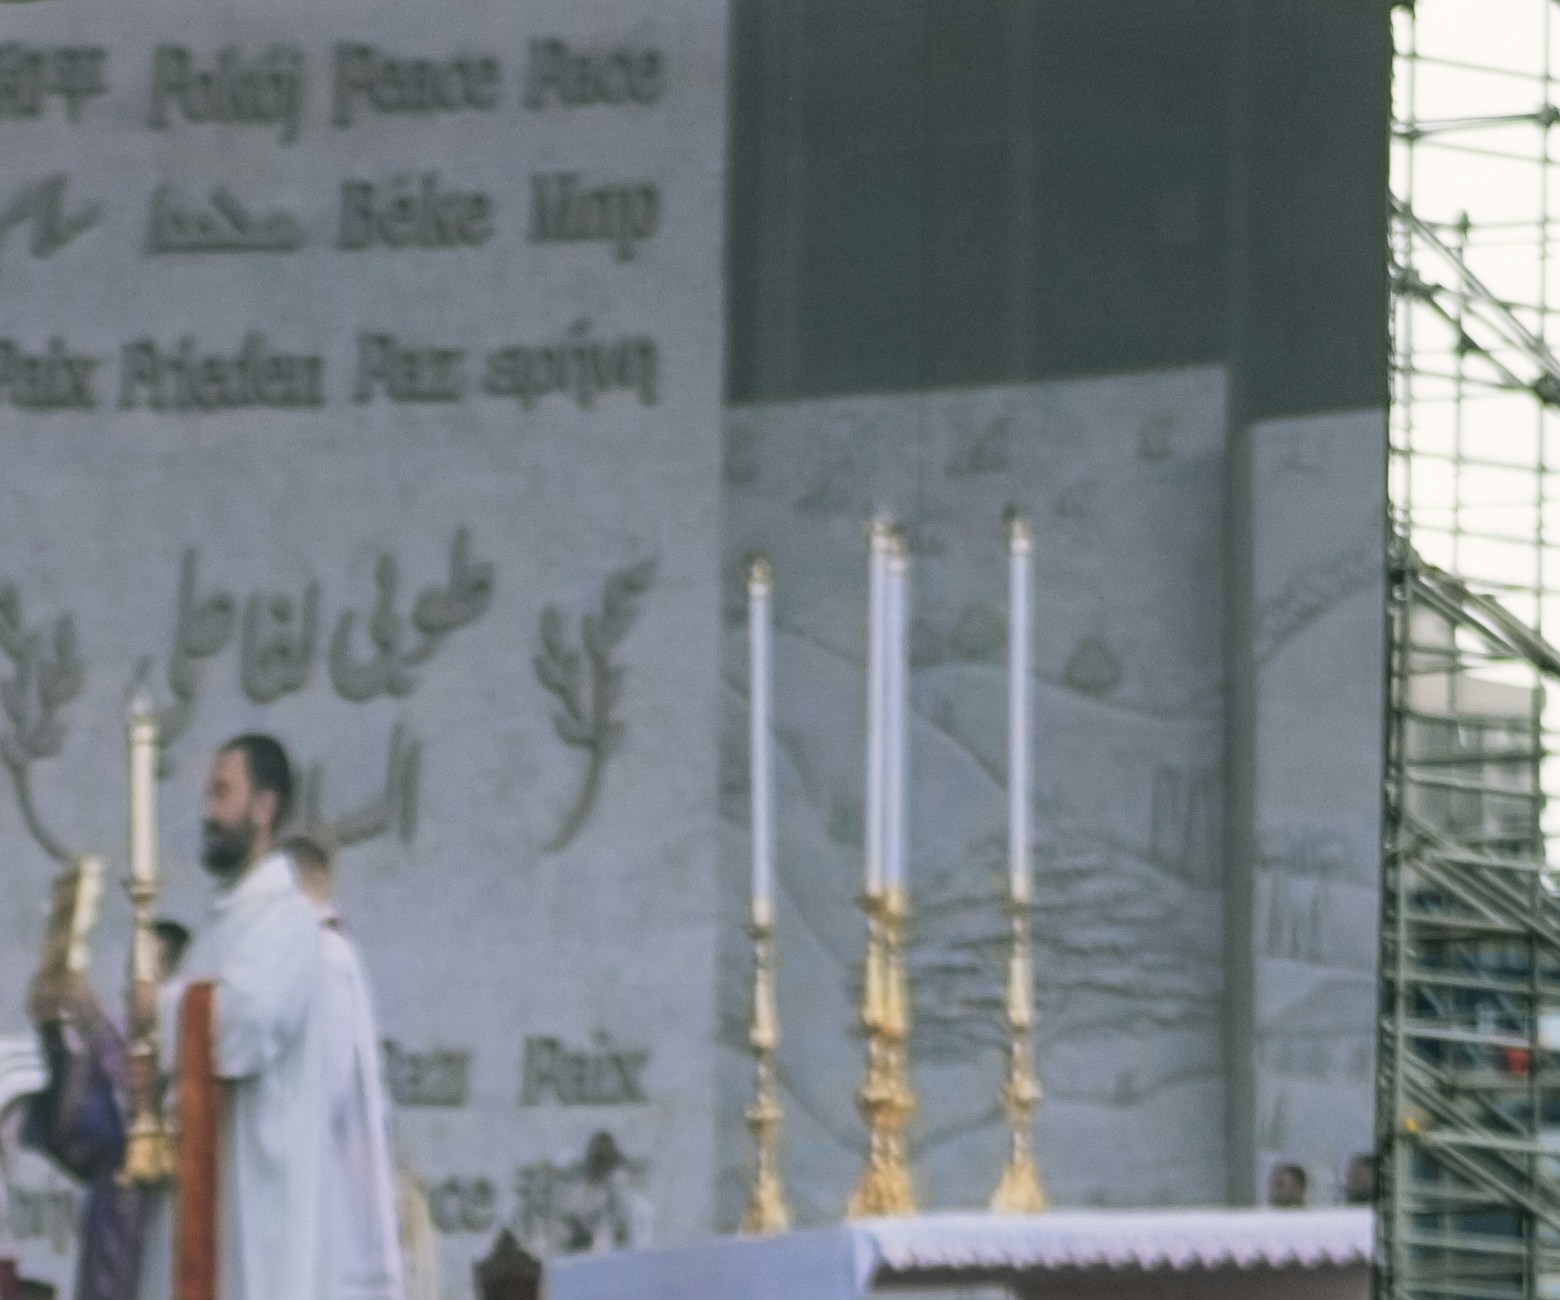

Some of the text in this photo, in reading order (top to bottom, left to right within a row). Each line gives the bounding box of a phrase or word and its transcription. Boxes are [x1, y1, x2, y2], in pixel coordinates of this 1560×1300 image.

[330, 41, 503, 130] Peace
[522, 36, 667, 112] Pace
[117, 330, 329, 413] Frieden
[520, 1028, 652, 1109] Paix
